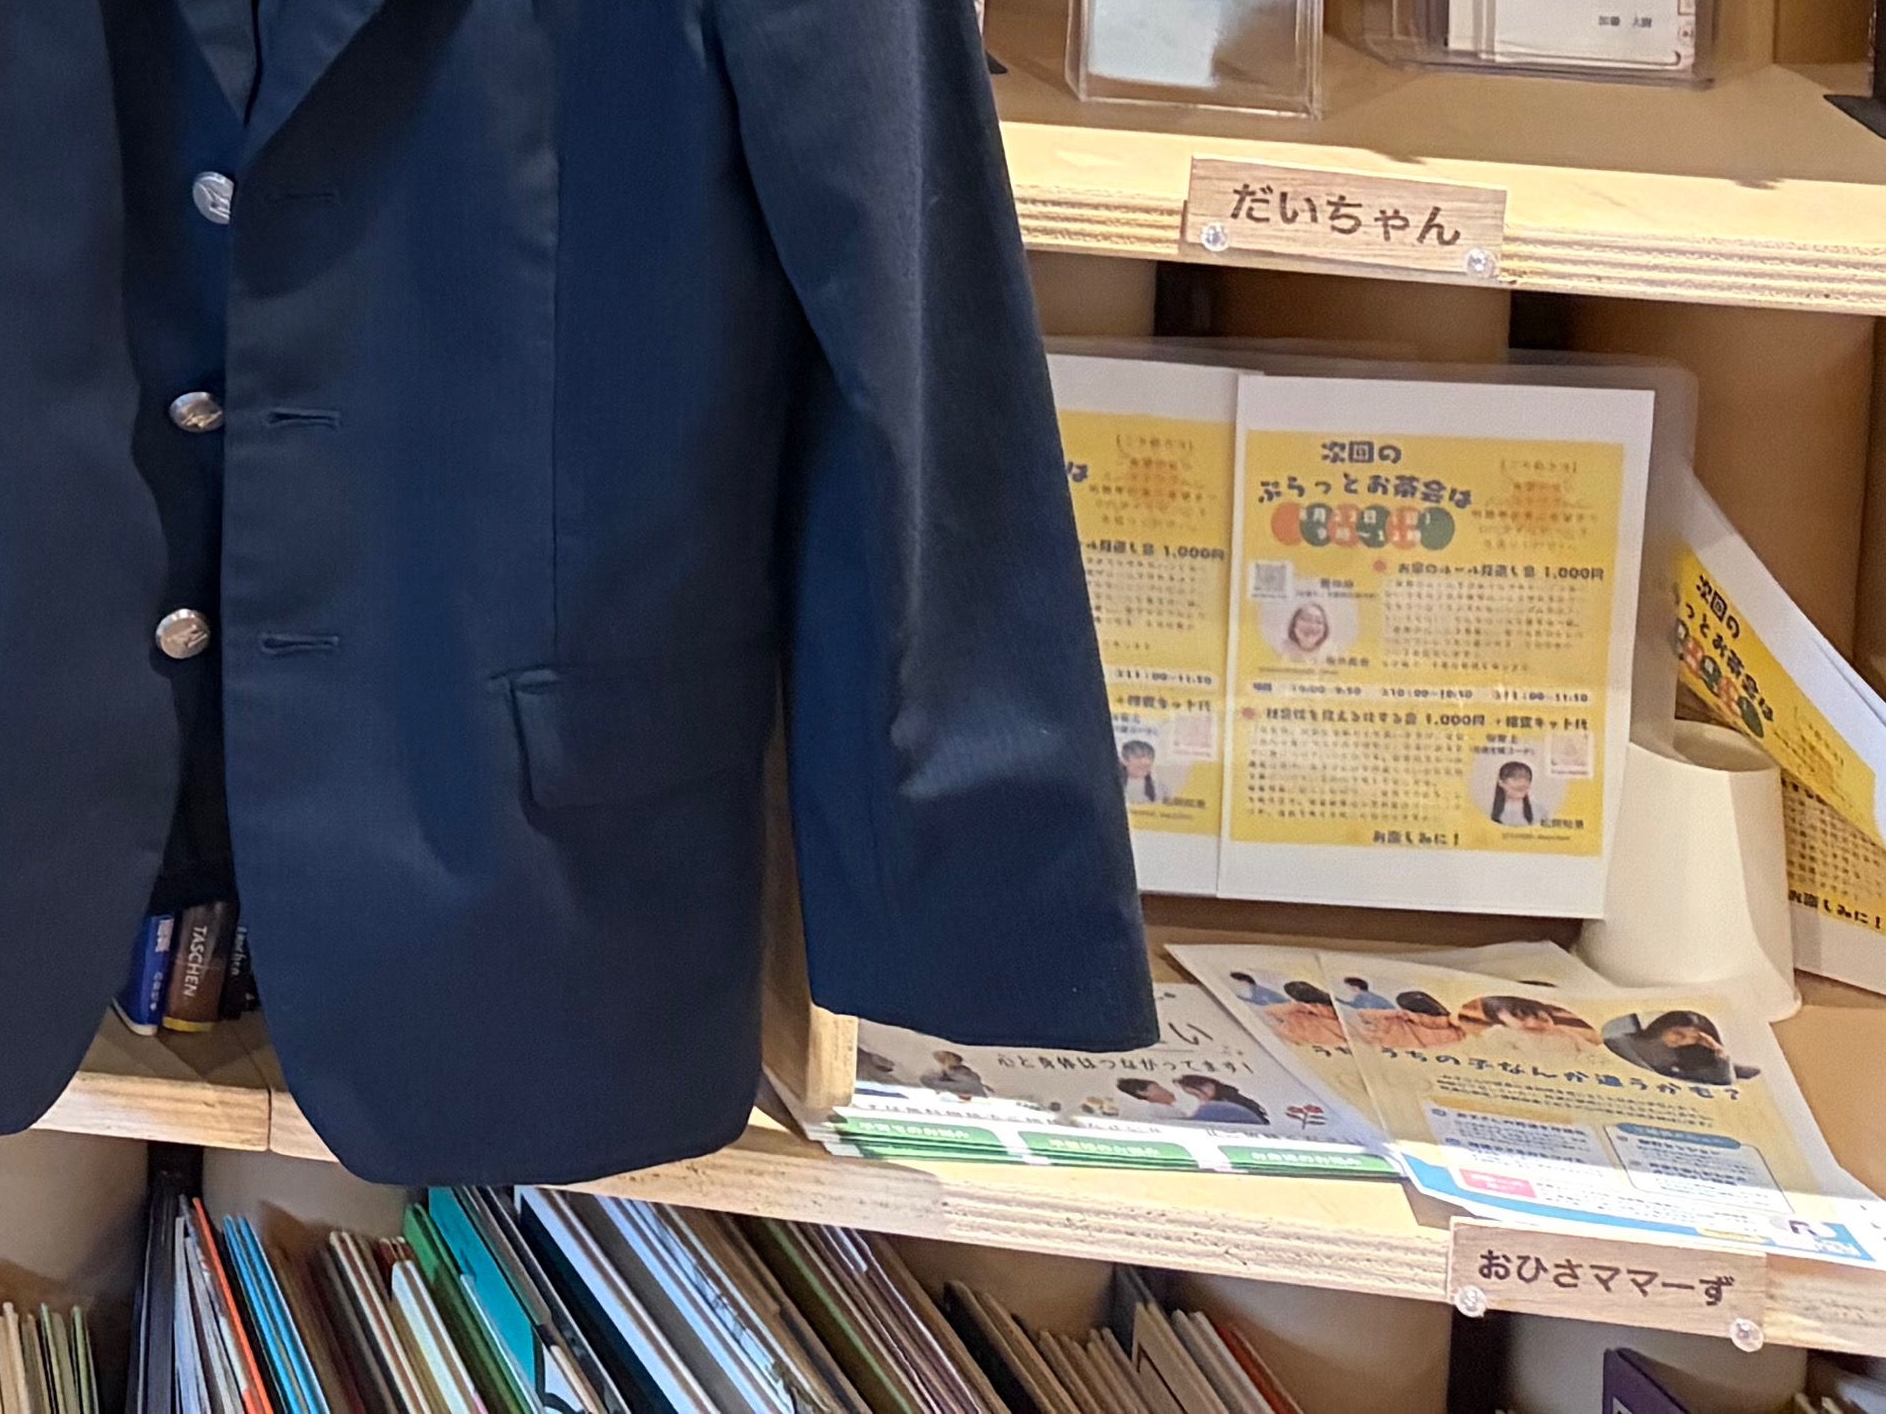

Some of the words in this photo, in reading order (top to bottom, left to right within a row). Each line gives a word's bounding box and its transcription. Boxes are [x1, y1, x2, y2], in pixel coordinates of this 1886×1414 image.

[1229, 183, 1462, 248] だいちゃん
[1320, 441, 1403, 464] 次回の
[1696, 573, 1741, 640] 次回の
[182, 925, 209, 998] TASCHEN
[1477, 1248, 1735, 1306] おひさママーず
